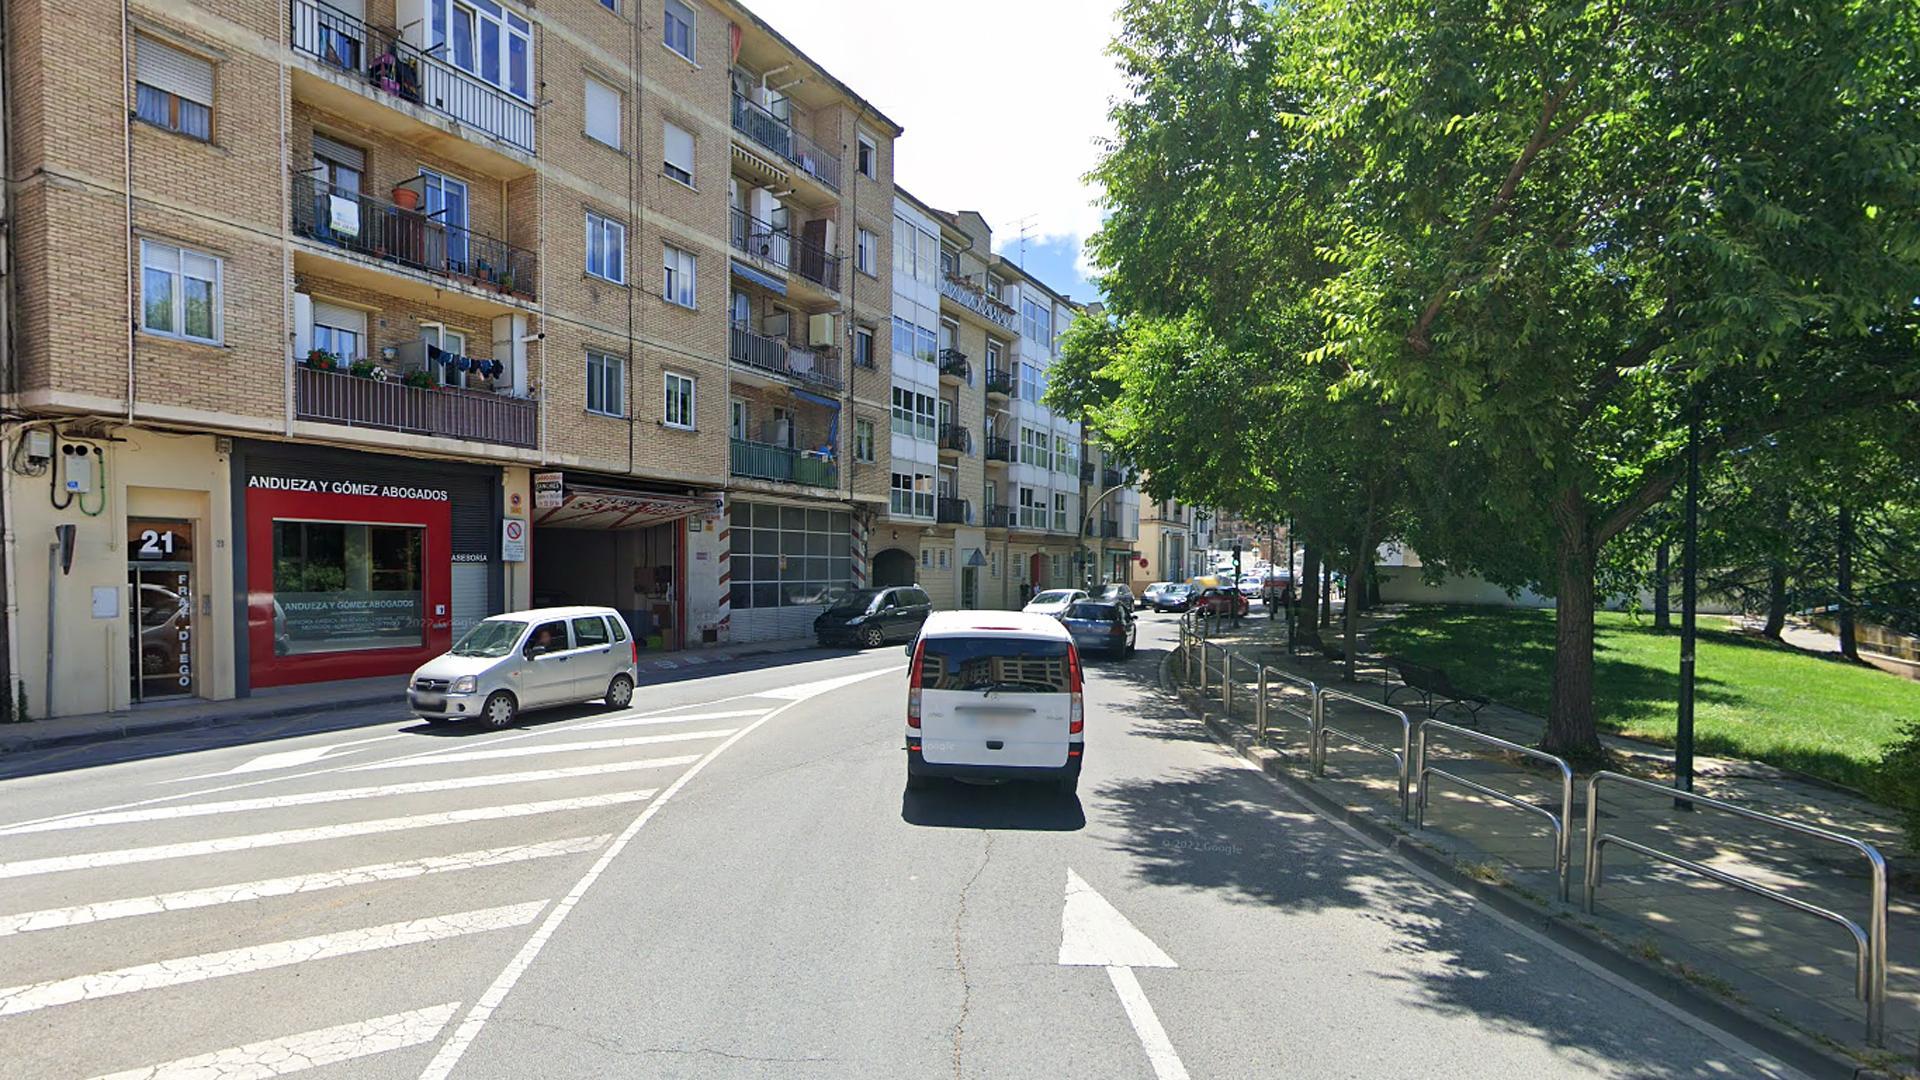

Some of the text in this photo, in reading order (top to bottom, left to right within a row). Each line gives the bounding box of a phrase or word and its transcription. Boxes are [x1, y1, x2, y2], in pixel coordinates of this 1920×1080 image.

[248, 475, 448, 501] ANDUEZA Y GÓMEZ ABOGADOS
[140, 529, 174, 553] 21
[284, 601, 328, 611] ANDUEZA
[328, 601, 336, 610] Y
[369, 599, 415, 609] ABOGADOS
[178, 574, 190, 687] FRAY DIEGO
